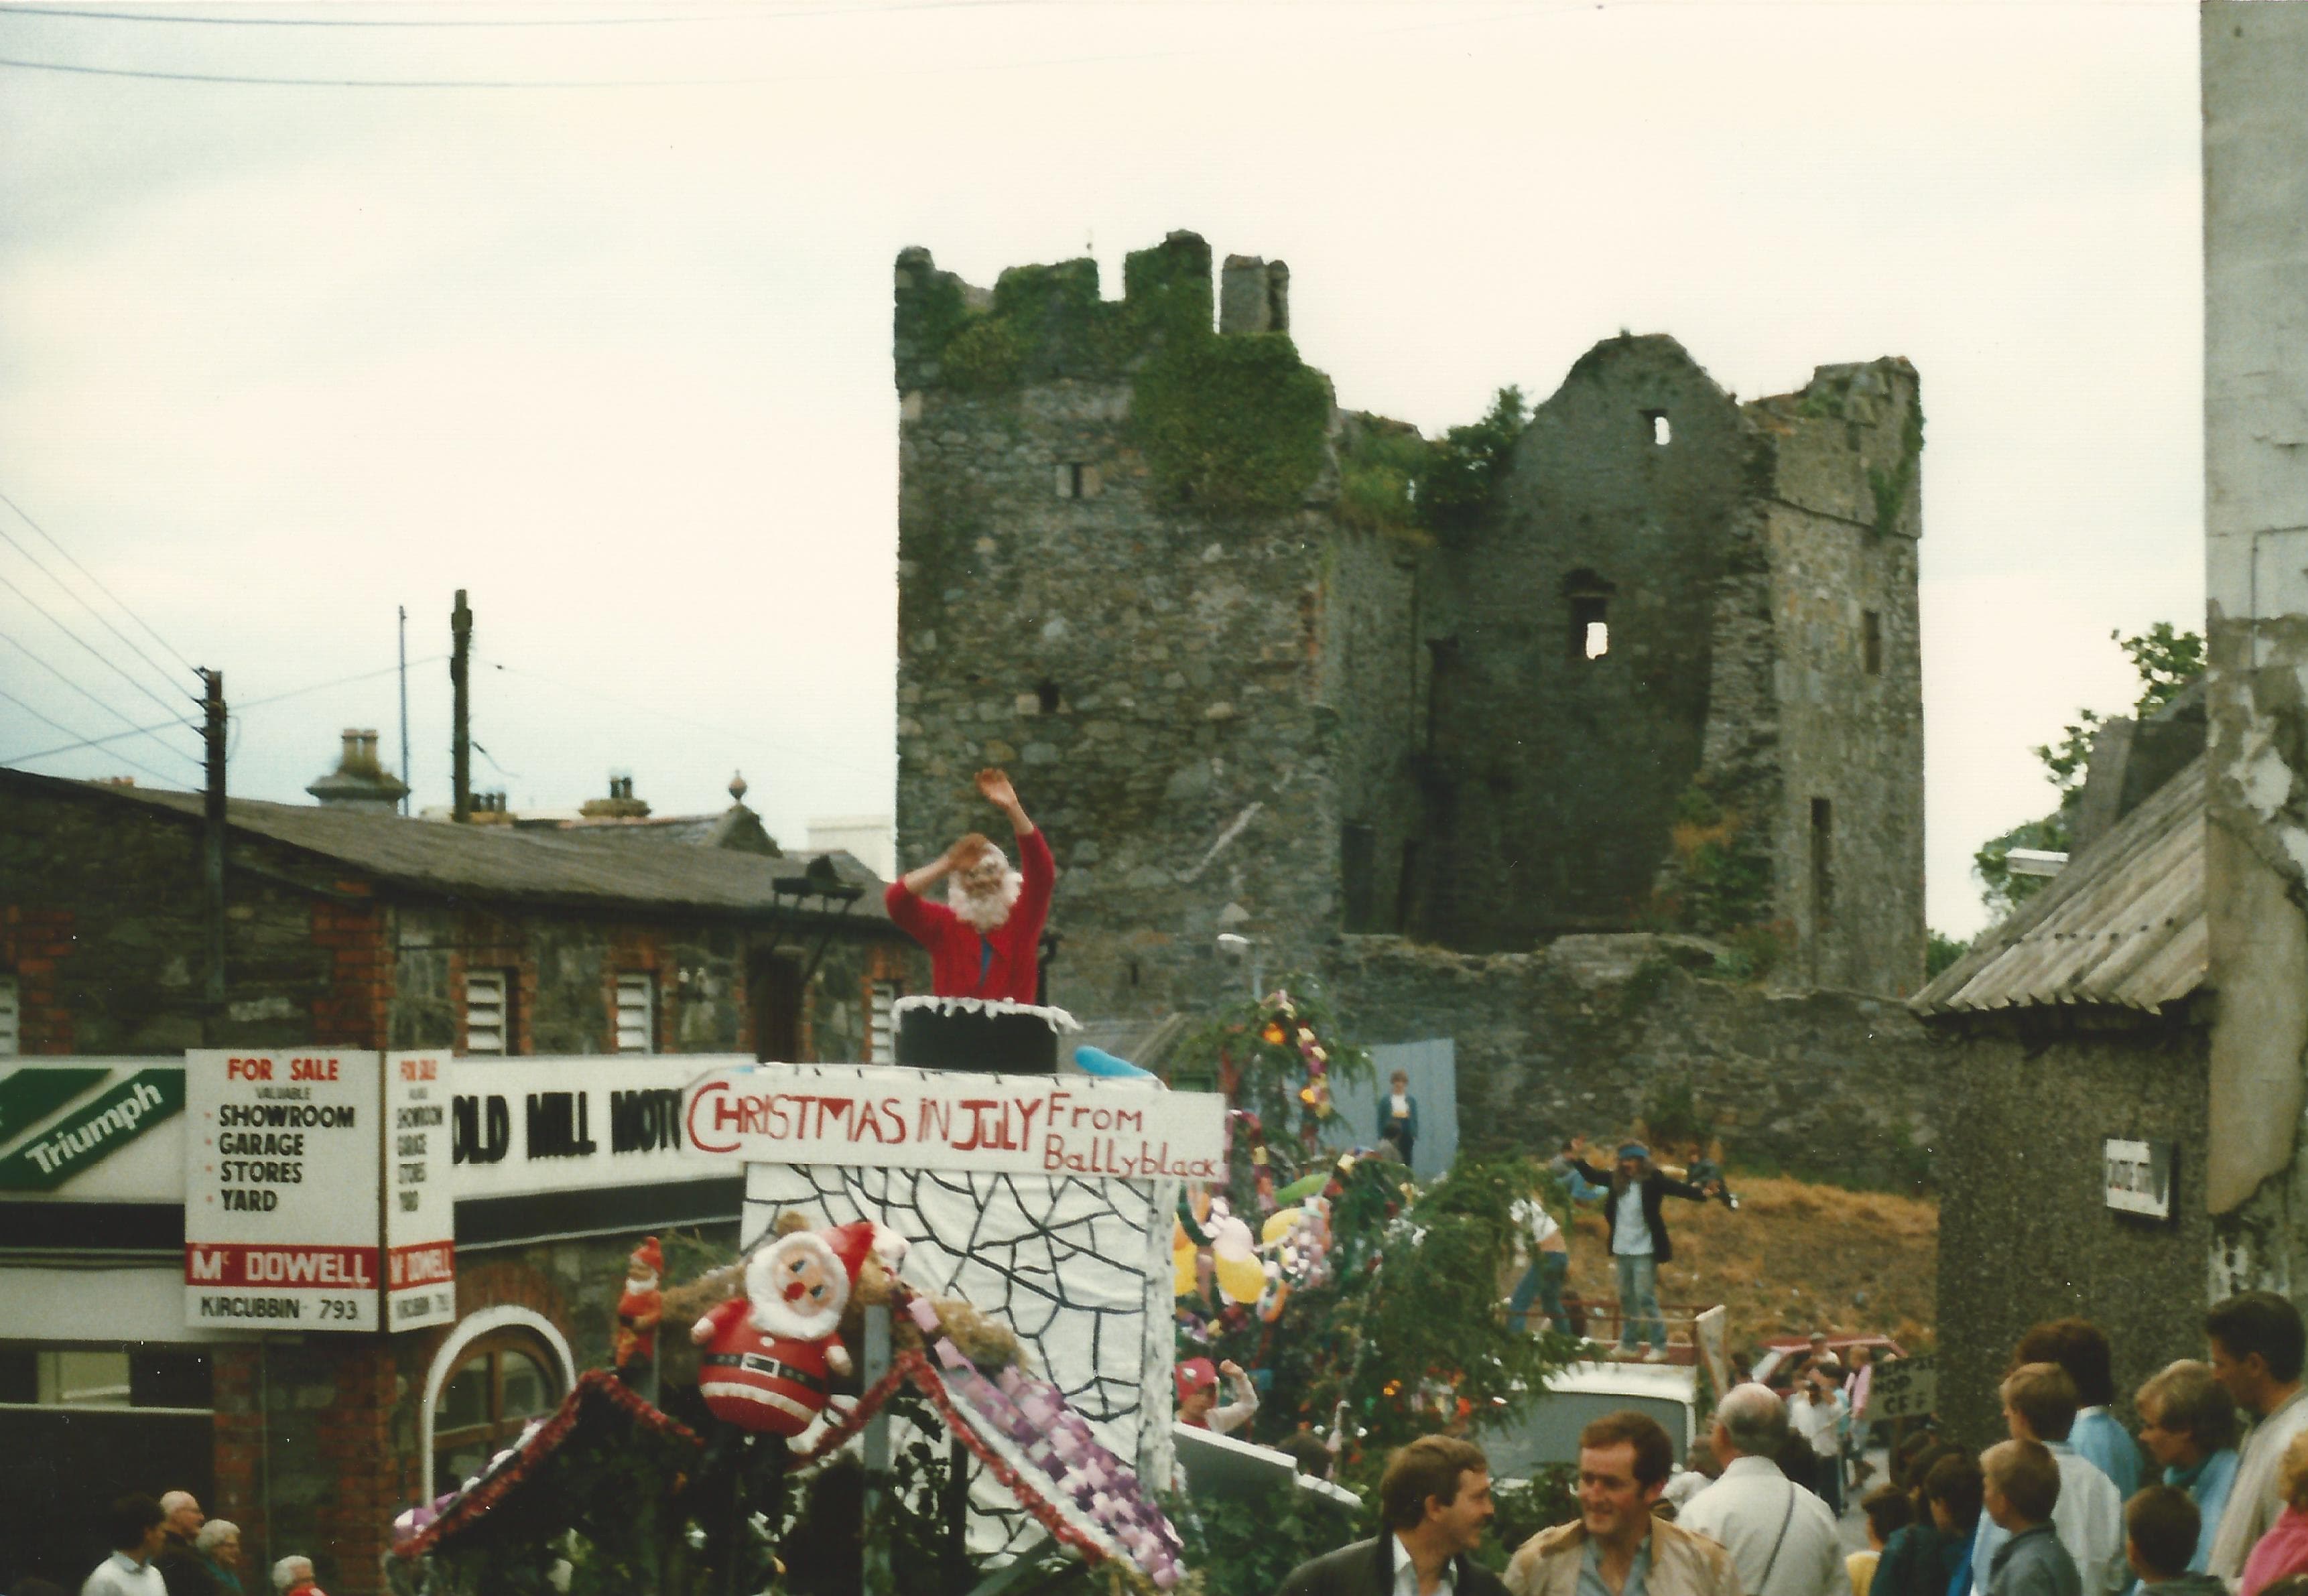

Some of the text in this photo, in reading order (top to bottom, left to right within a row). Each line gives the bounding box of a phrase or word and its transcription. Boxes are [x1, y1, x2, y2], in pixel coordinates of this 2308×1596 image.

[228, 1058, 338, 1081] FOR SALE
[24, 1082, 164, 1173] Triumph
[220, 1105, 355, 1128] SHOWROOM
[527, 1091, 596, 1160] MILL
[688, 1082, 907, 1152] CHRISTMAS
[220, 1133, 304, 1155] GARAGE
[220, 1161, 303, 1183] STORES
[221, 1189, 278, 1211] YARD
[246, 1252, 371, 1283] DOWELL
[320, 1299, 358, 1319] 793
